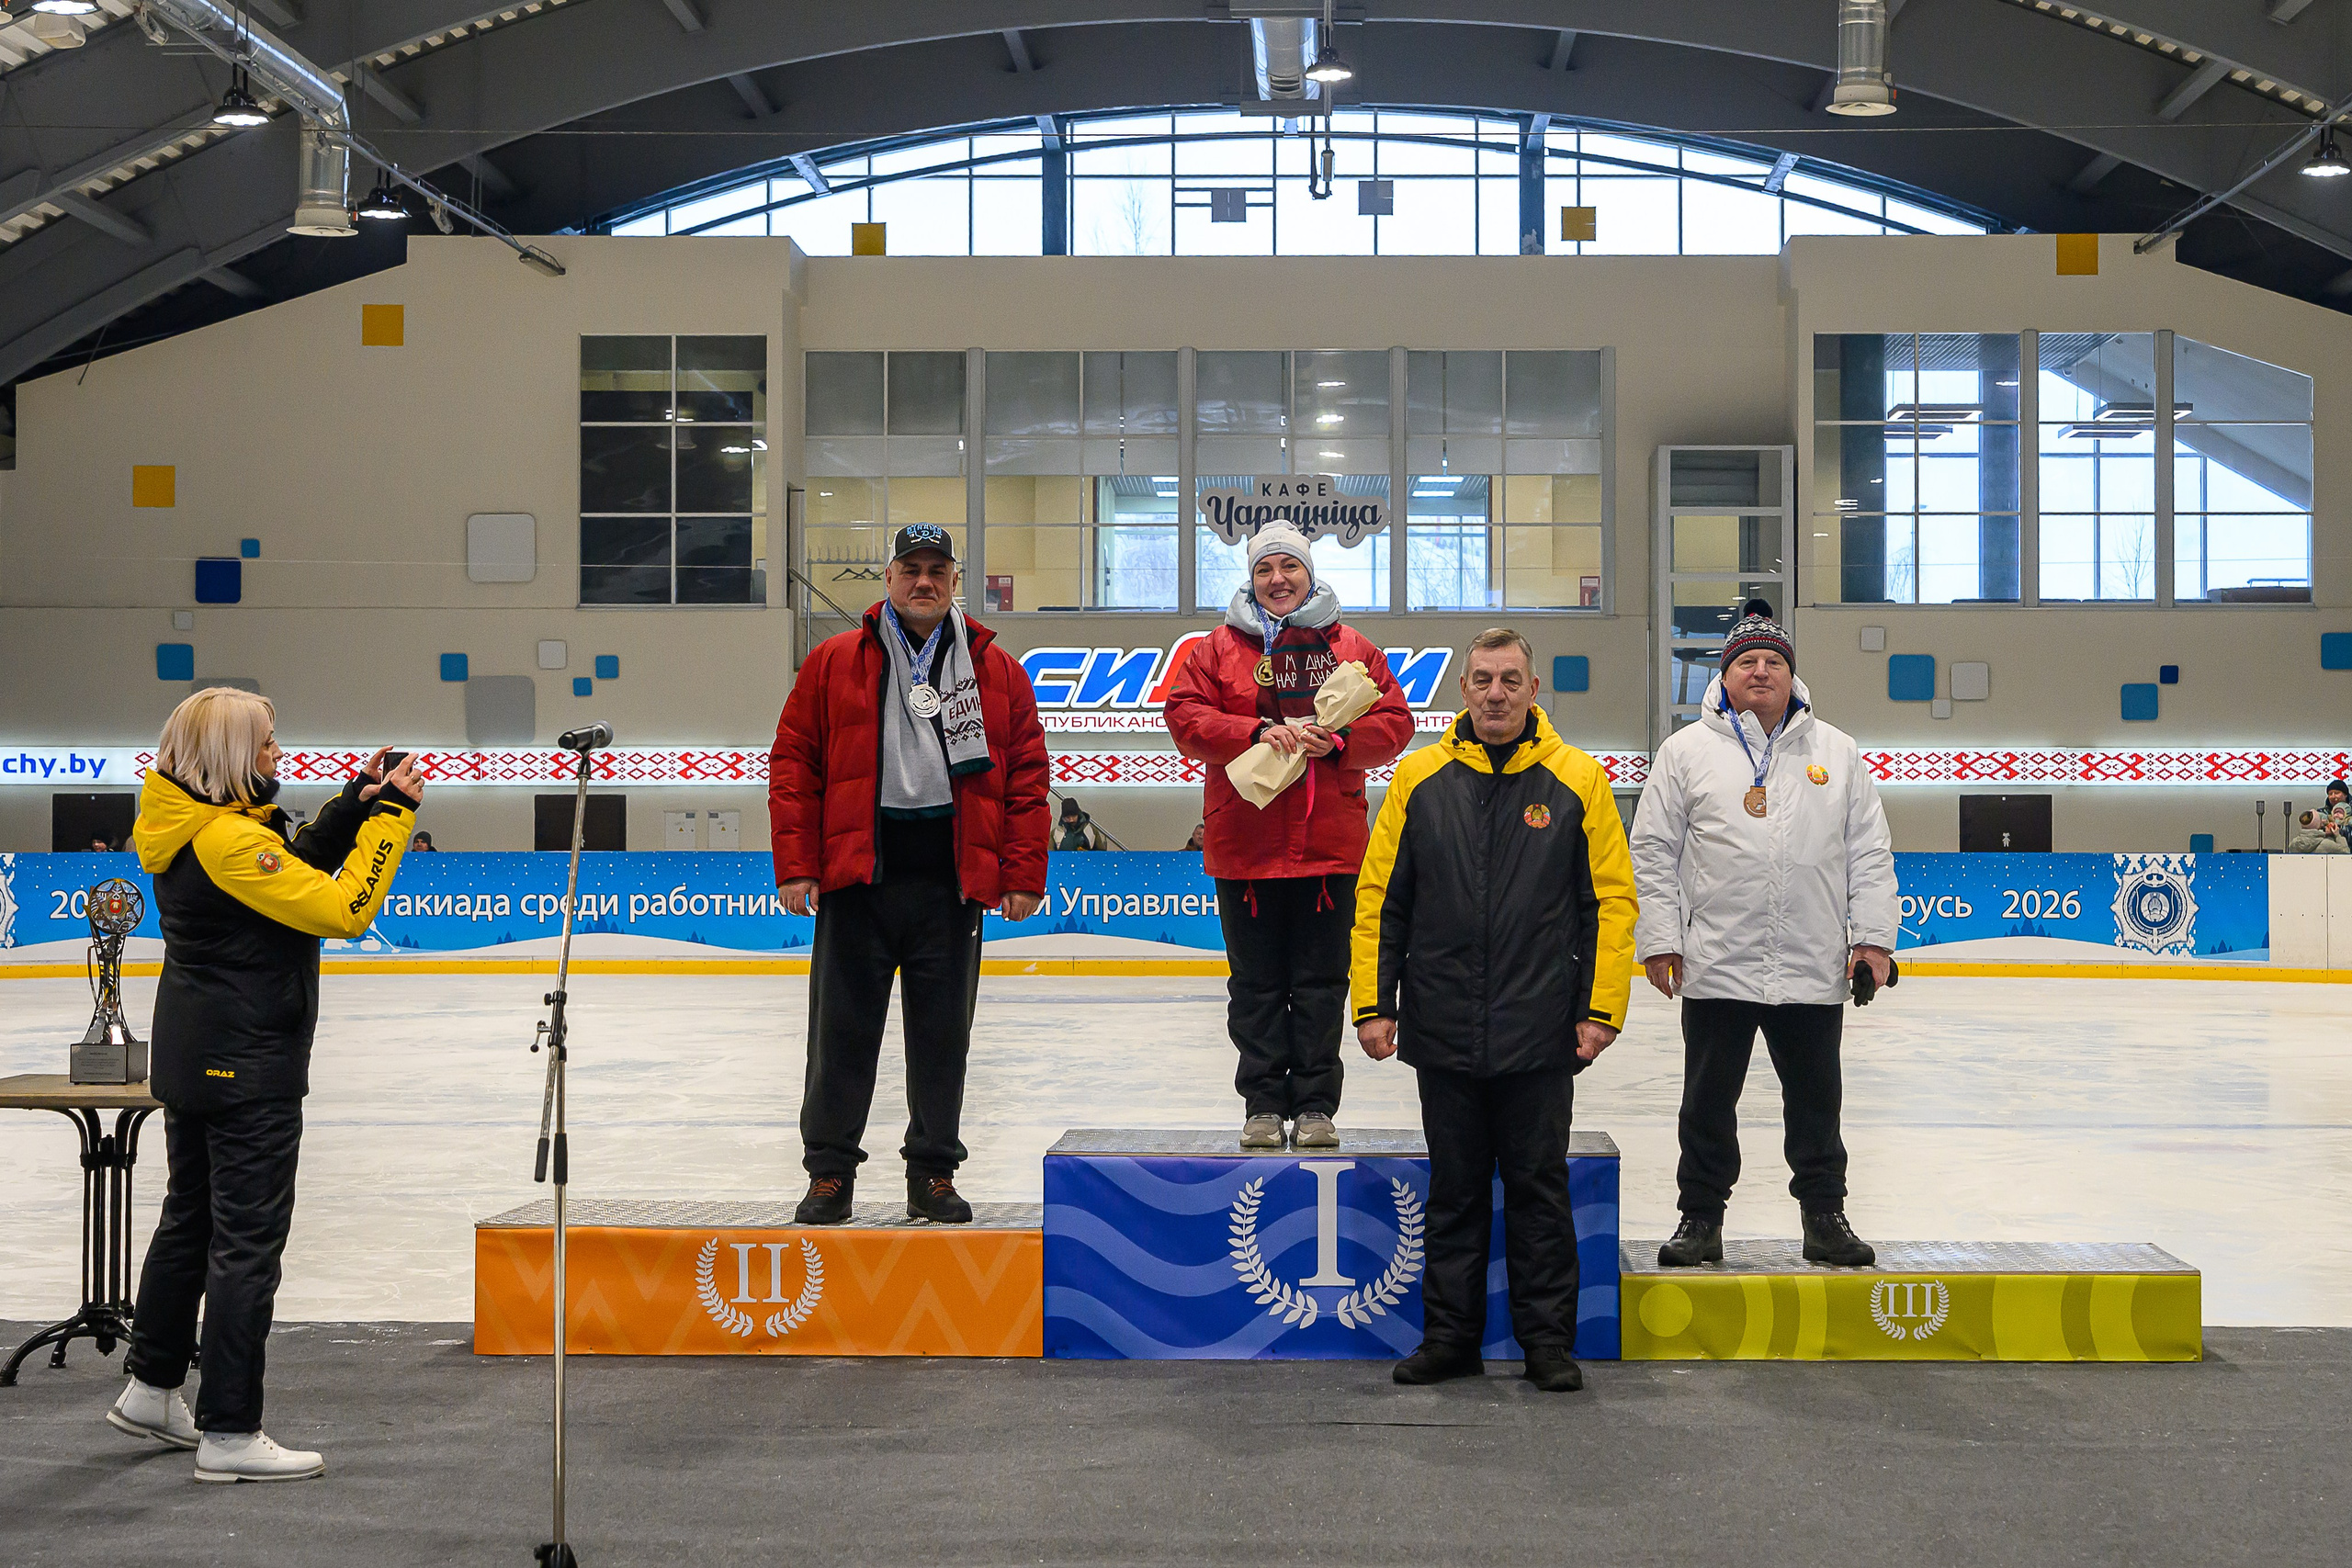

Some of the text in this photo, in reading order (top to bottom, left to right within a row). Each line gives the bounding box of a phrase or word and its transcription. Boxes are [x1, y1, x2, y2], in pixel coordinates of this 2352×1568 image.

[1261, 482, 1327, 497] КАФЕ
[2, 752, 107, 779] chy.by
[348, 839, 394, 916] BELARUS
[382, 894, 512, 922] такиада
[520, 893, 618, 922] среди
[629, 886, 798, 922] работник
[1059, 886, 1220, 923] Управлен
[1896, 895, 1973, 926] русь
[2001, 889, 2083, 919] 2026
[206, 1068, 235, 1078] ORAZ
[1298, 1161, 1356, 1286] I
[729, 1243, 790, 1303] II
[1883, 1283, 1937, 1317] III
